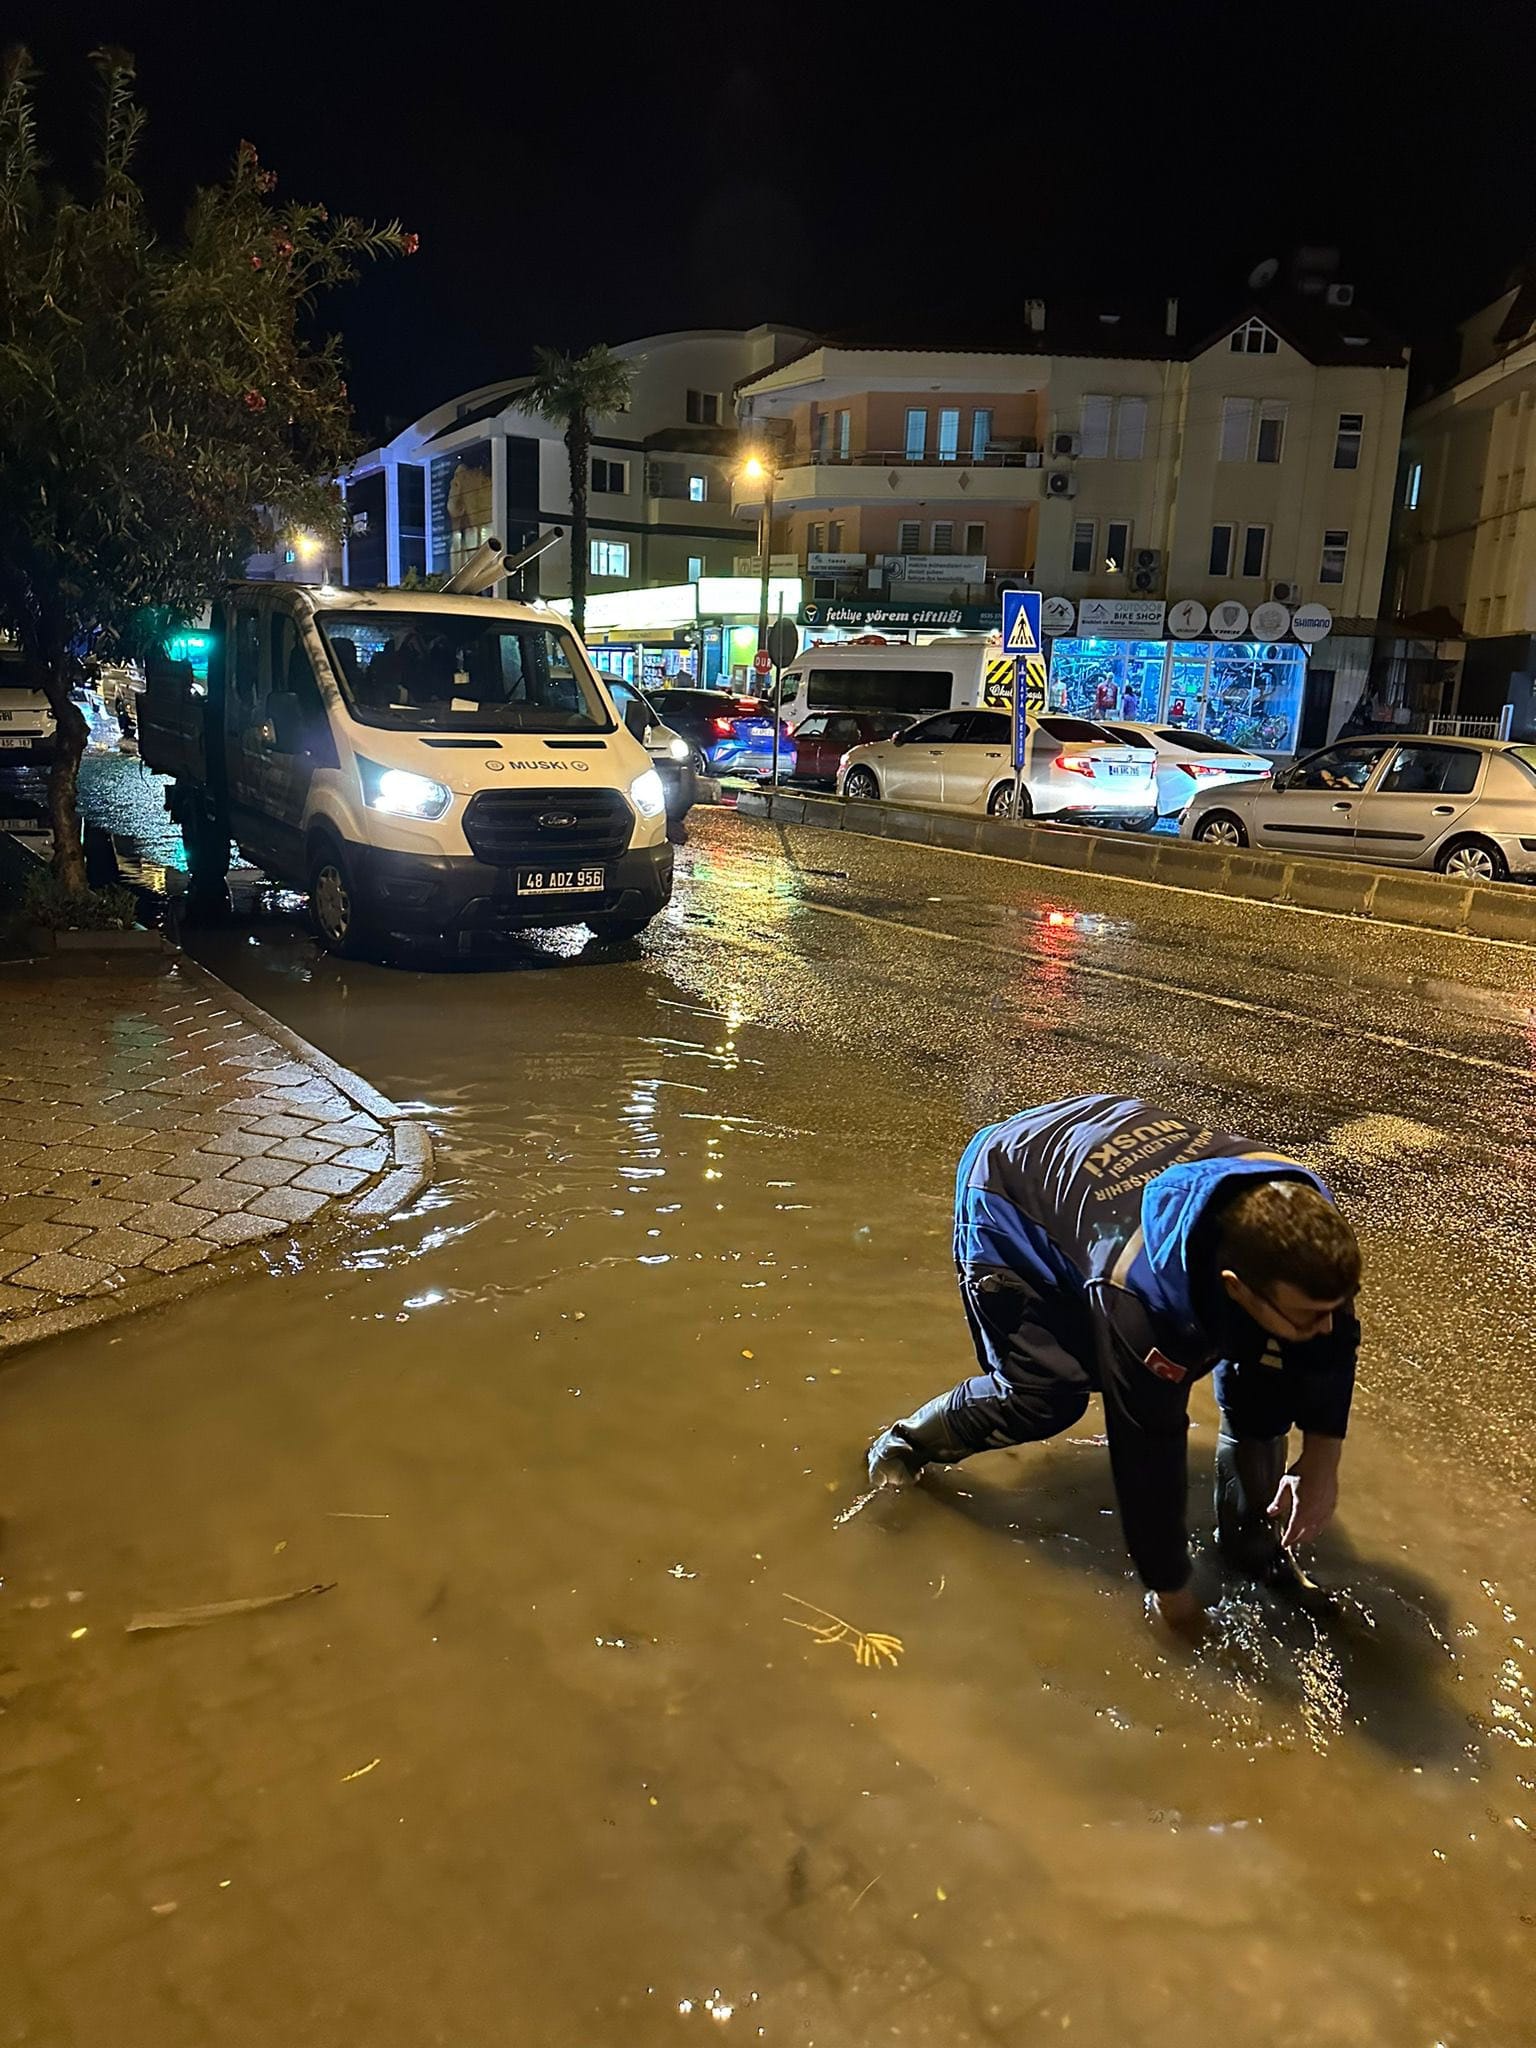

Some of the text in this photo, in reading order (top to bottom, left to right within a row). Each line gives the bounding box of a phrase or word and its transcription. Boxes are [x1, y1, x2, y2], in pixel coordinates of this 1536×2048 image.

[1113, 602, 1162, 612] OUTDOOR
[826, 606, 962, 625] fethiye yörem çiftliği
[1136, 613, 1162, 621] SHOP
[1293, 618, 1330, 628] SHIMANO
[755, 656, 772, 668] DUR
[989, 684, 1013, 698] Okul
[547, 815, 569, 825] Ford
[526, 871, 601, 889] 48 ADZ 956
[1082, 1119, 1188, 1179] MUSKİ
